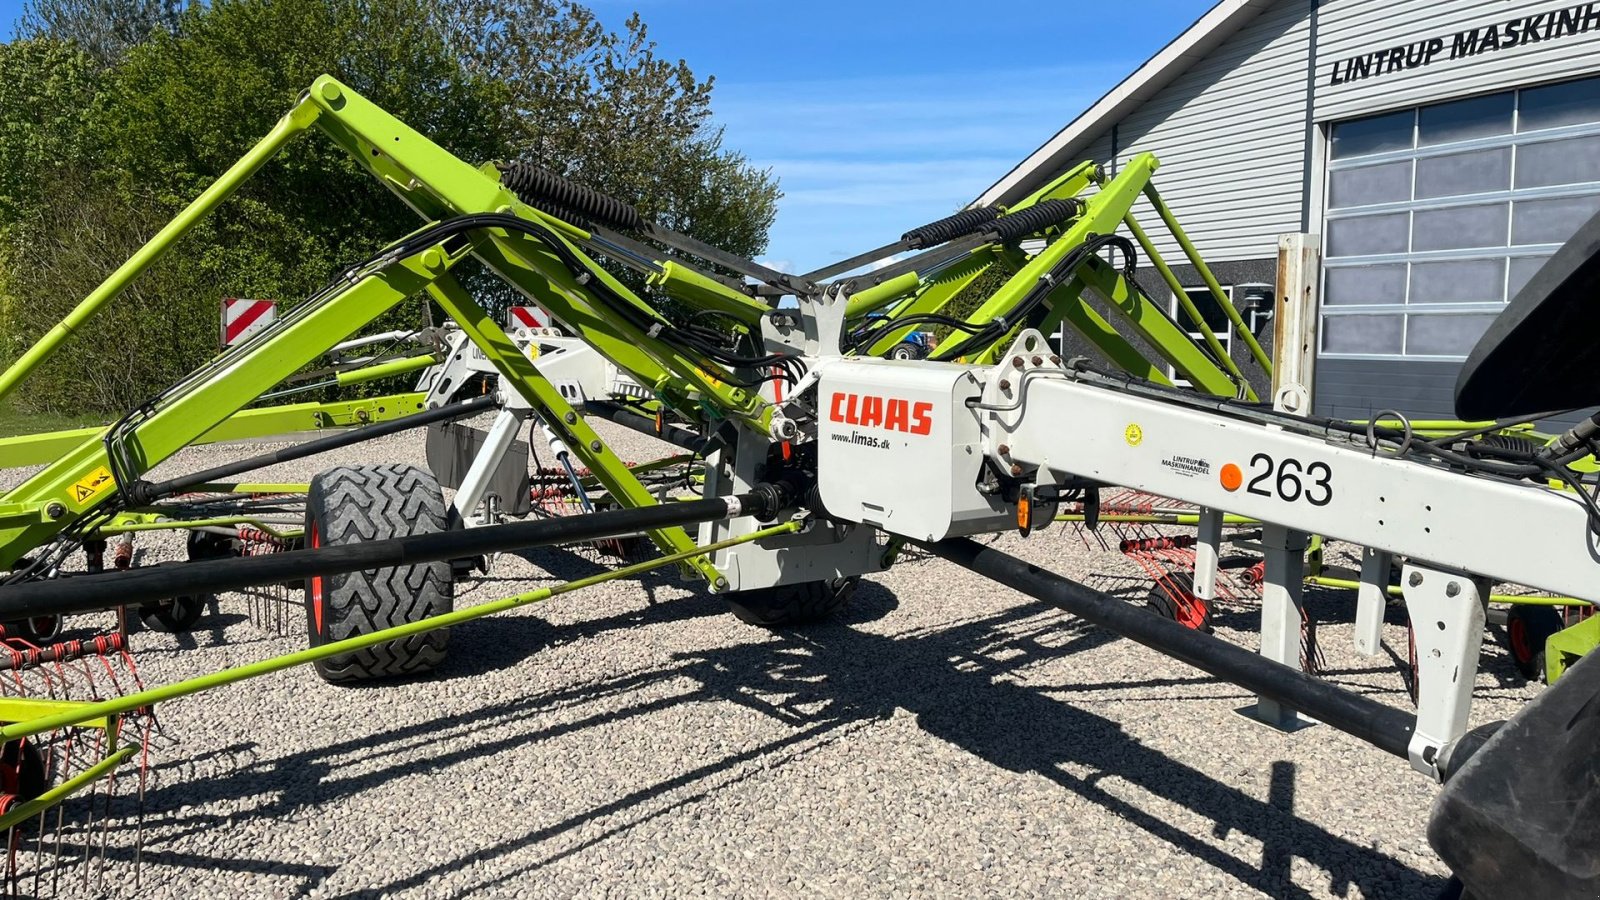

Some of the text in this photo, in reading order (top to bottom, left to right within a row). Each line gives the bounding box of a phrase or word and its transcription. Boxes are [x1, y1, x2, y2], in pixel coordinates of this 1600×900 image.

[1331, 3, 1600, 86] LINTRUP MASKINH
[829, 392, 933, 436] CLAAS
[831, 430, 891, 450] www.limas.dk
[1161, 459, 1210, 475] MASKINHANDEL
[1246, 452, 1333, 507] 263
